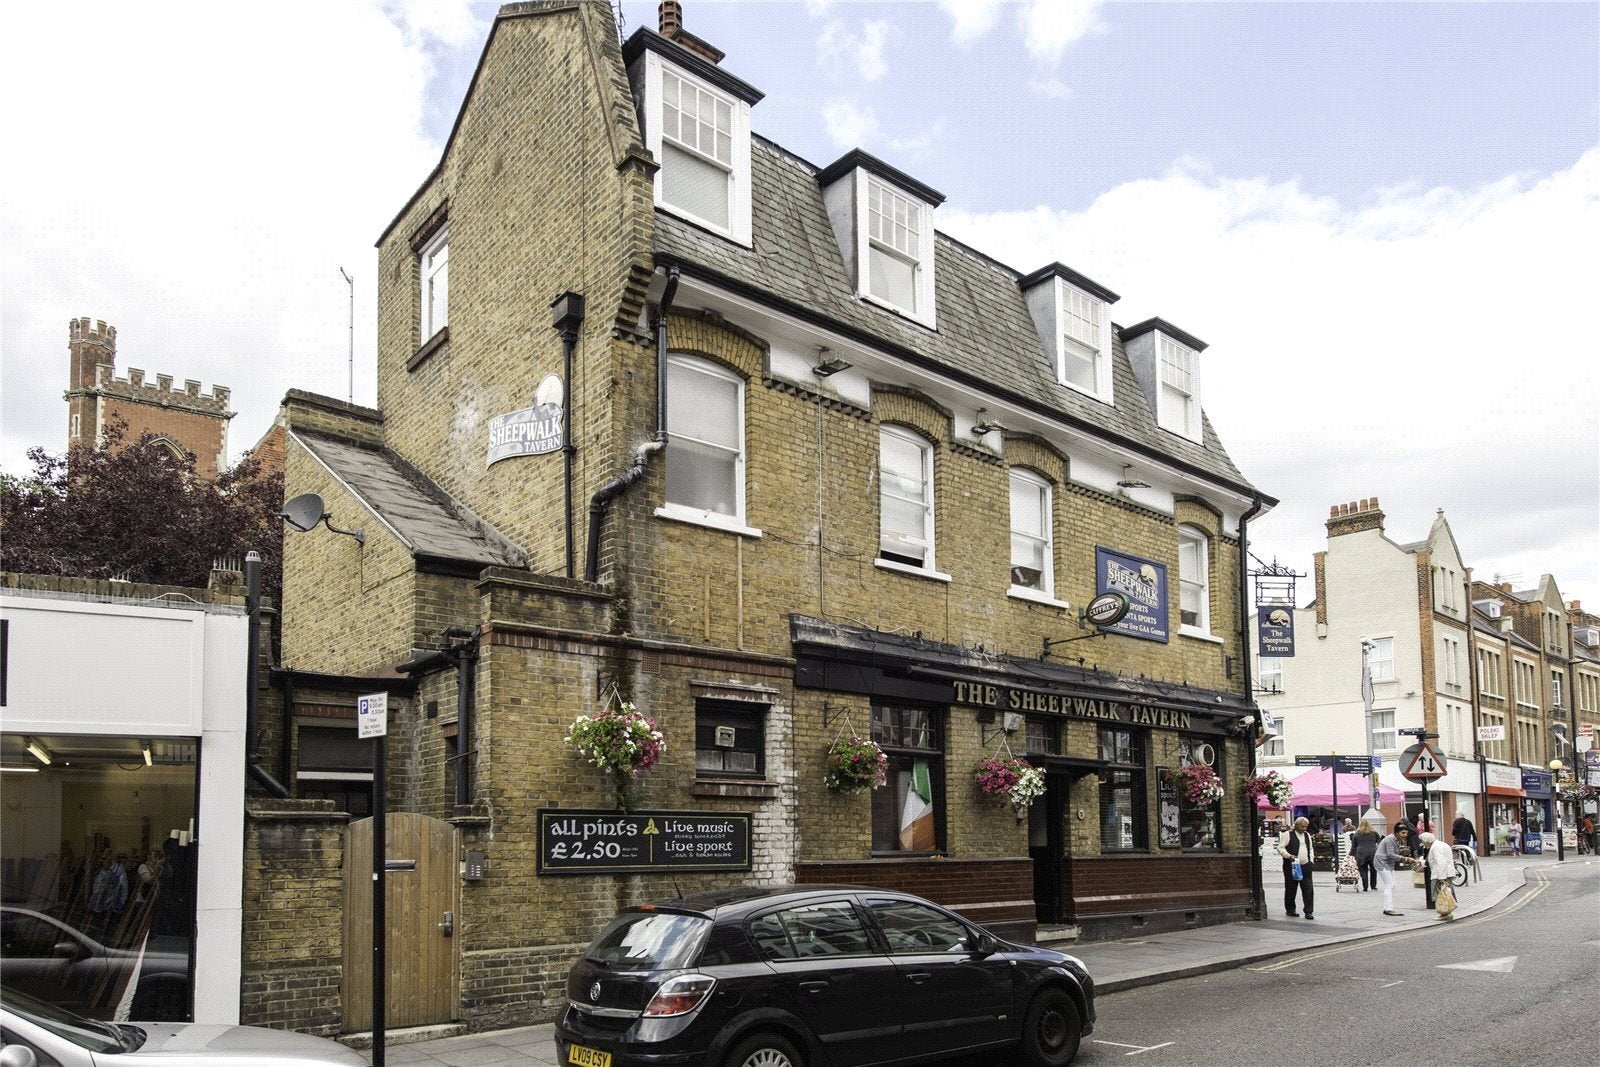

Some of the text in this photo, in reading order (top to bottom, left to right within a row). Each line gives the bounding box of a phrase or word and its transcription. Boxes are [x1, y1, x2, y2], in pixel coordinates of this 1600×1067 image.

[490, 416, 504, 430] THE
[489, 415, 562, 448] SHEEPWALK
[524, 435, 561, 452] TAVERN
[1108, 568, 1158, 600] SHEEPWALK
[1135, 591, 1158, 607] TAVERN
[1129, 603, 1148, 613] SPORTS
[1138, 614, 1157, 625] SPORTS
[1139, 625, 1150, 633] GAA
[361, 701, 367, 713] P
[953, 680, 1191, 729] THE SHEEPWALK TAVERN
[584, 819, 638, 840] pints
[665, 820, 734, 832] Live music
[551, 841, 620, 859] £2.50
[665, 840, 733, 853] Live sport
[573, 1047, 608, 1067] LV09 CSY
